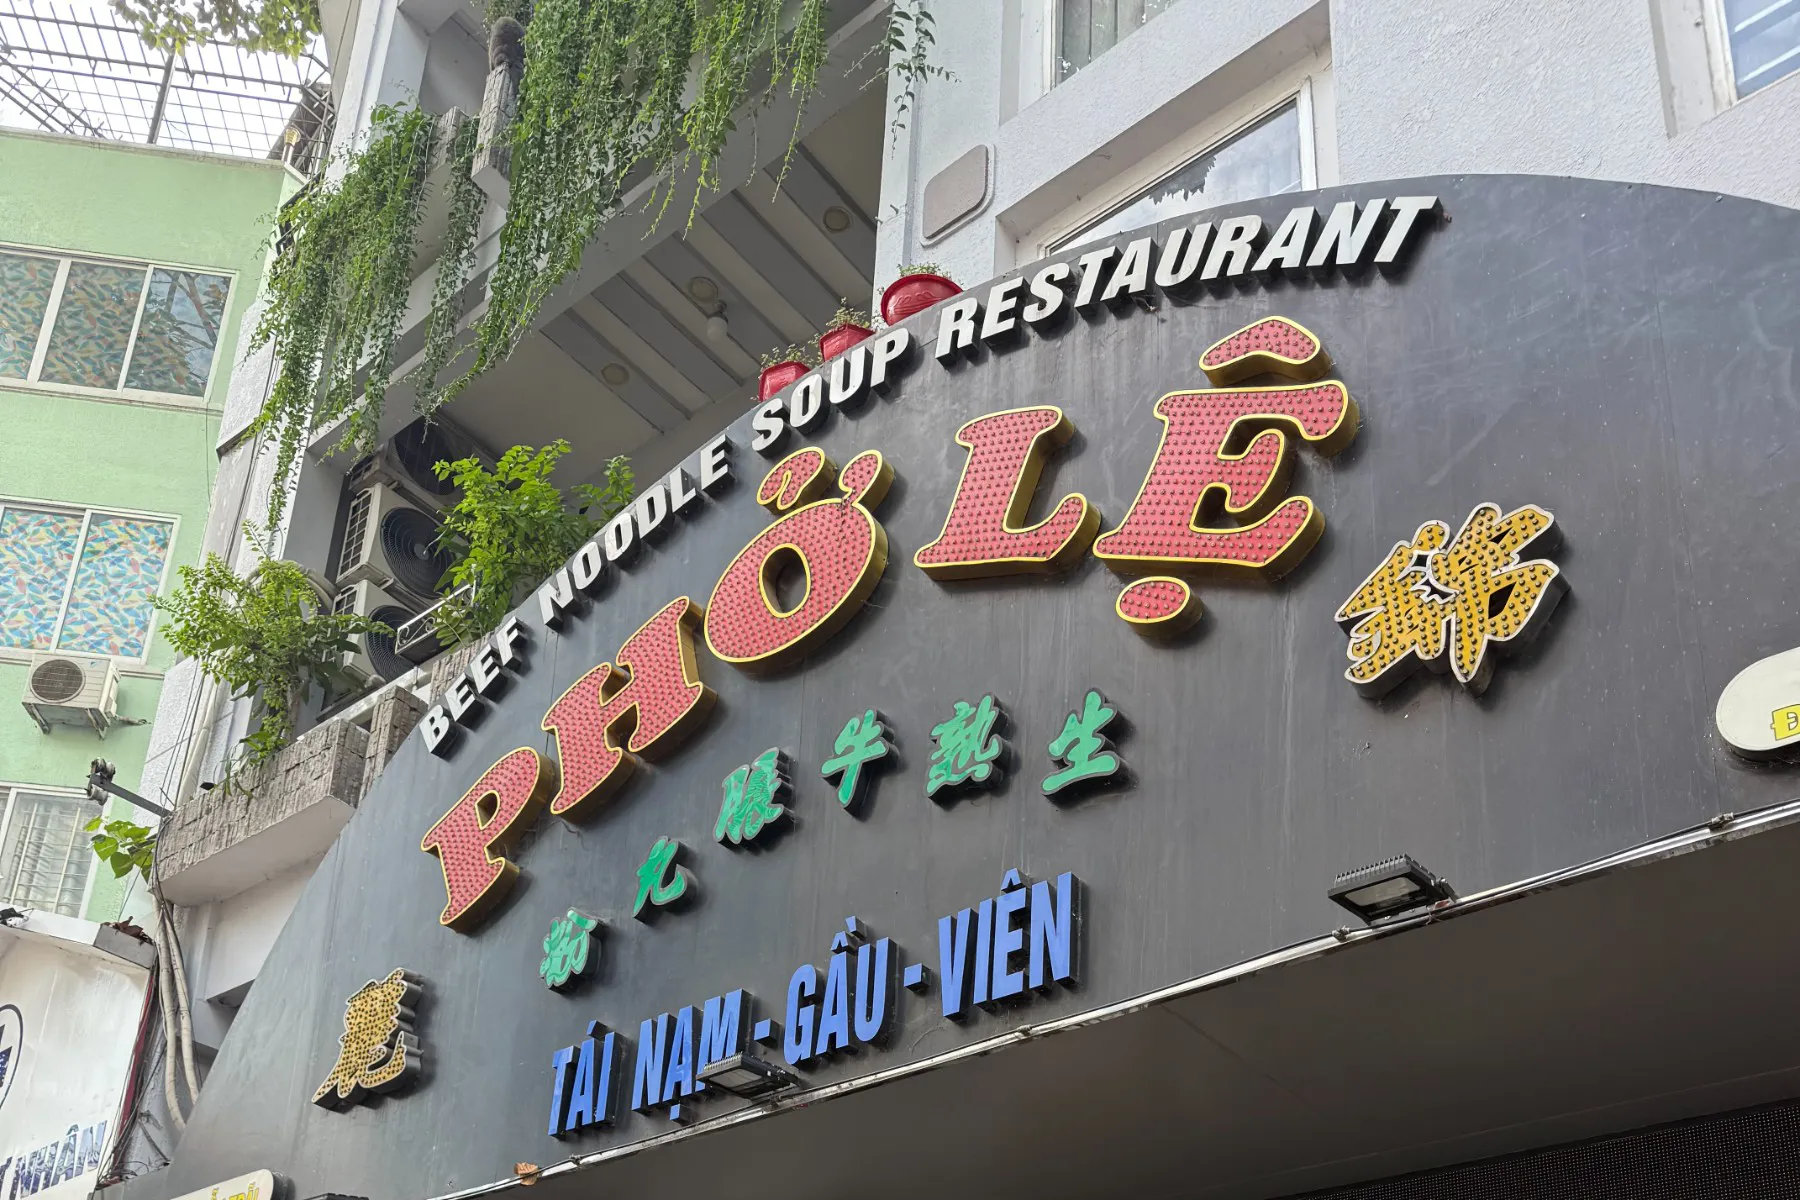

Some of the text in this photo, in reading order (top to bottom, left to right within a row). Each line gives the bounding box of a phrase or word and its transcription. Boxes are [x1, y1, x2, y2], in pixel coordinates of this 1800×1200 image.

[420, 194, 1438, 754] BEEF NOODLE SOUP RESTAURANT
[420, 315, 1352, 928] PHỞ LỆ
[548, 1019, 616, 1136] TÁI
[632, 989, 745, 1121] NẠM
[784, 916, 892, 1067] GẦU
[938, 869, 1075, 1019] VIÊN
